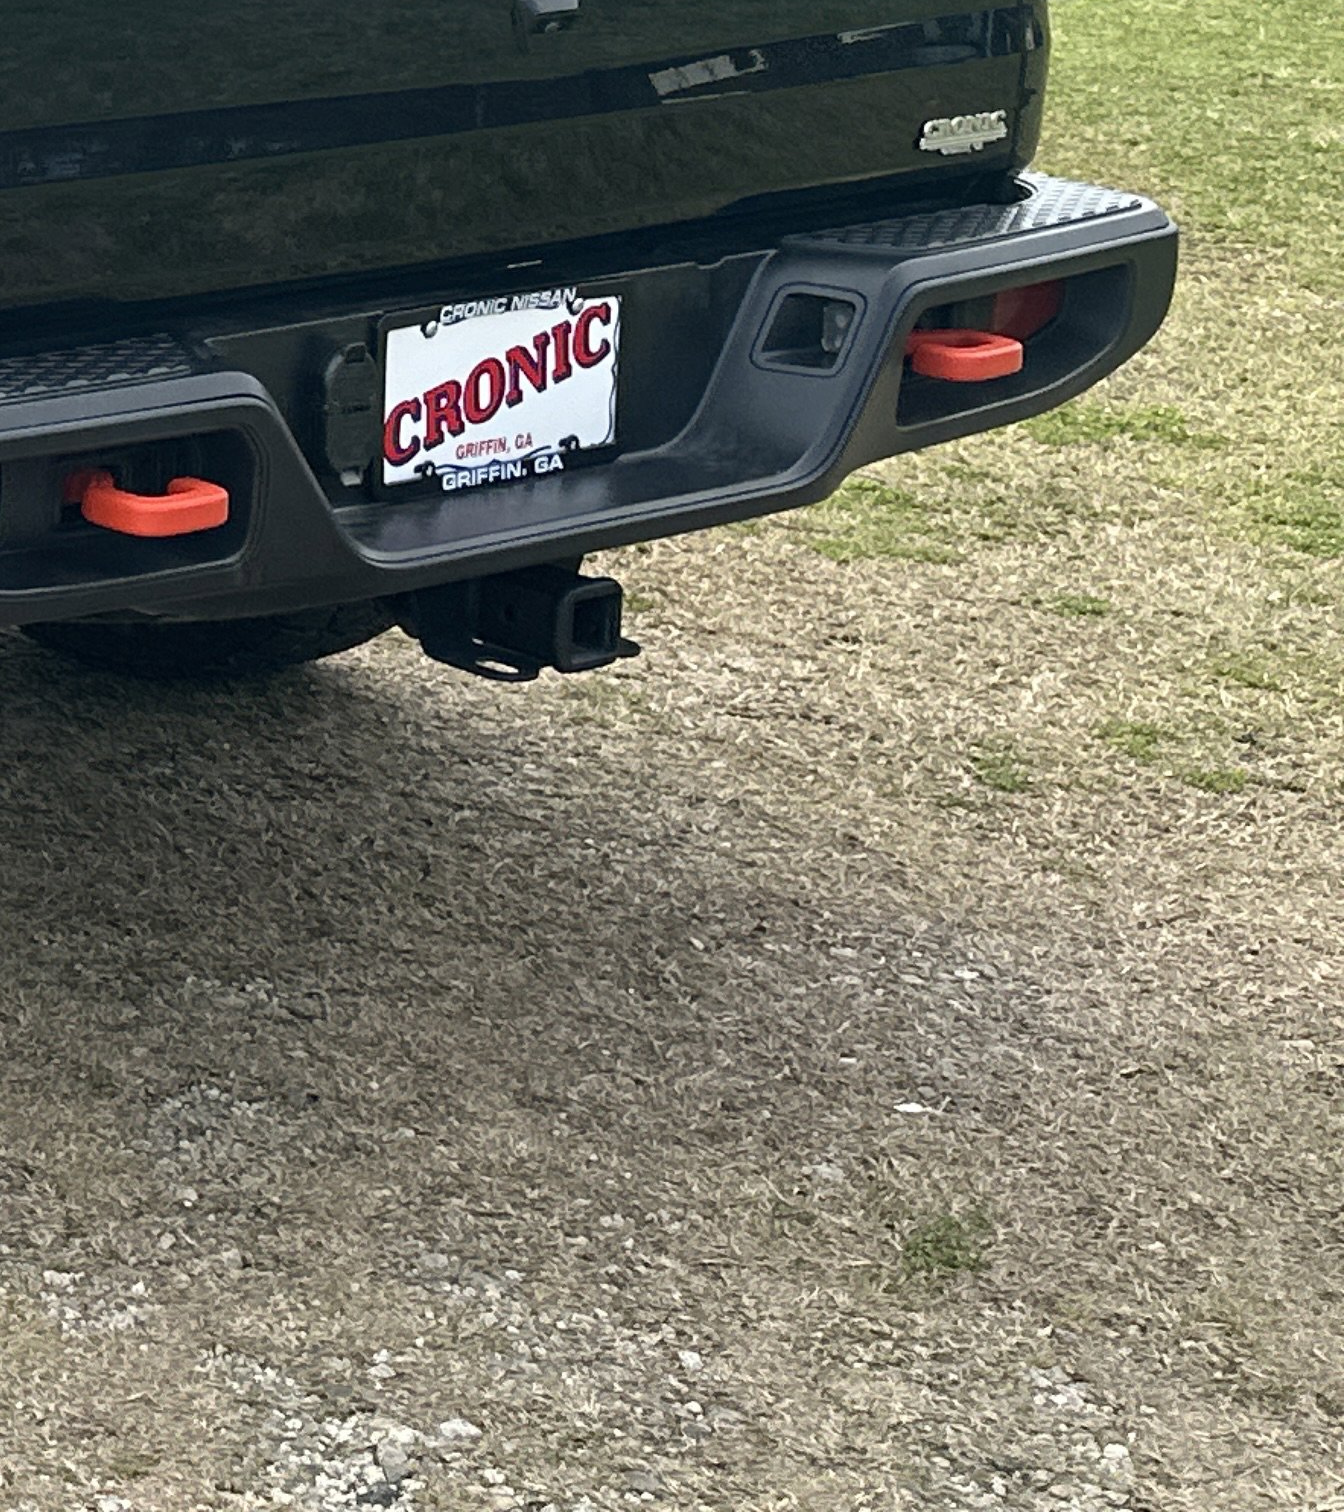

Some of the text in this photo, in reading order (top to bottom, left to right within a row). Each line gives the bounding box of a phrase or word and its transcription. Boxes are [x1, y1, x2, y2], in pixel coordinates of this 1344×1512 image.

[440, 287, 577, 324] CRONIC NISSAN
[383, 302, 612, 467] CRONIC
[514, 432, 534, 450] GA
[533, 454, 564, 475] GA
